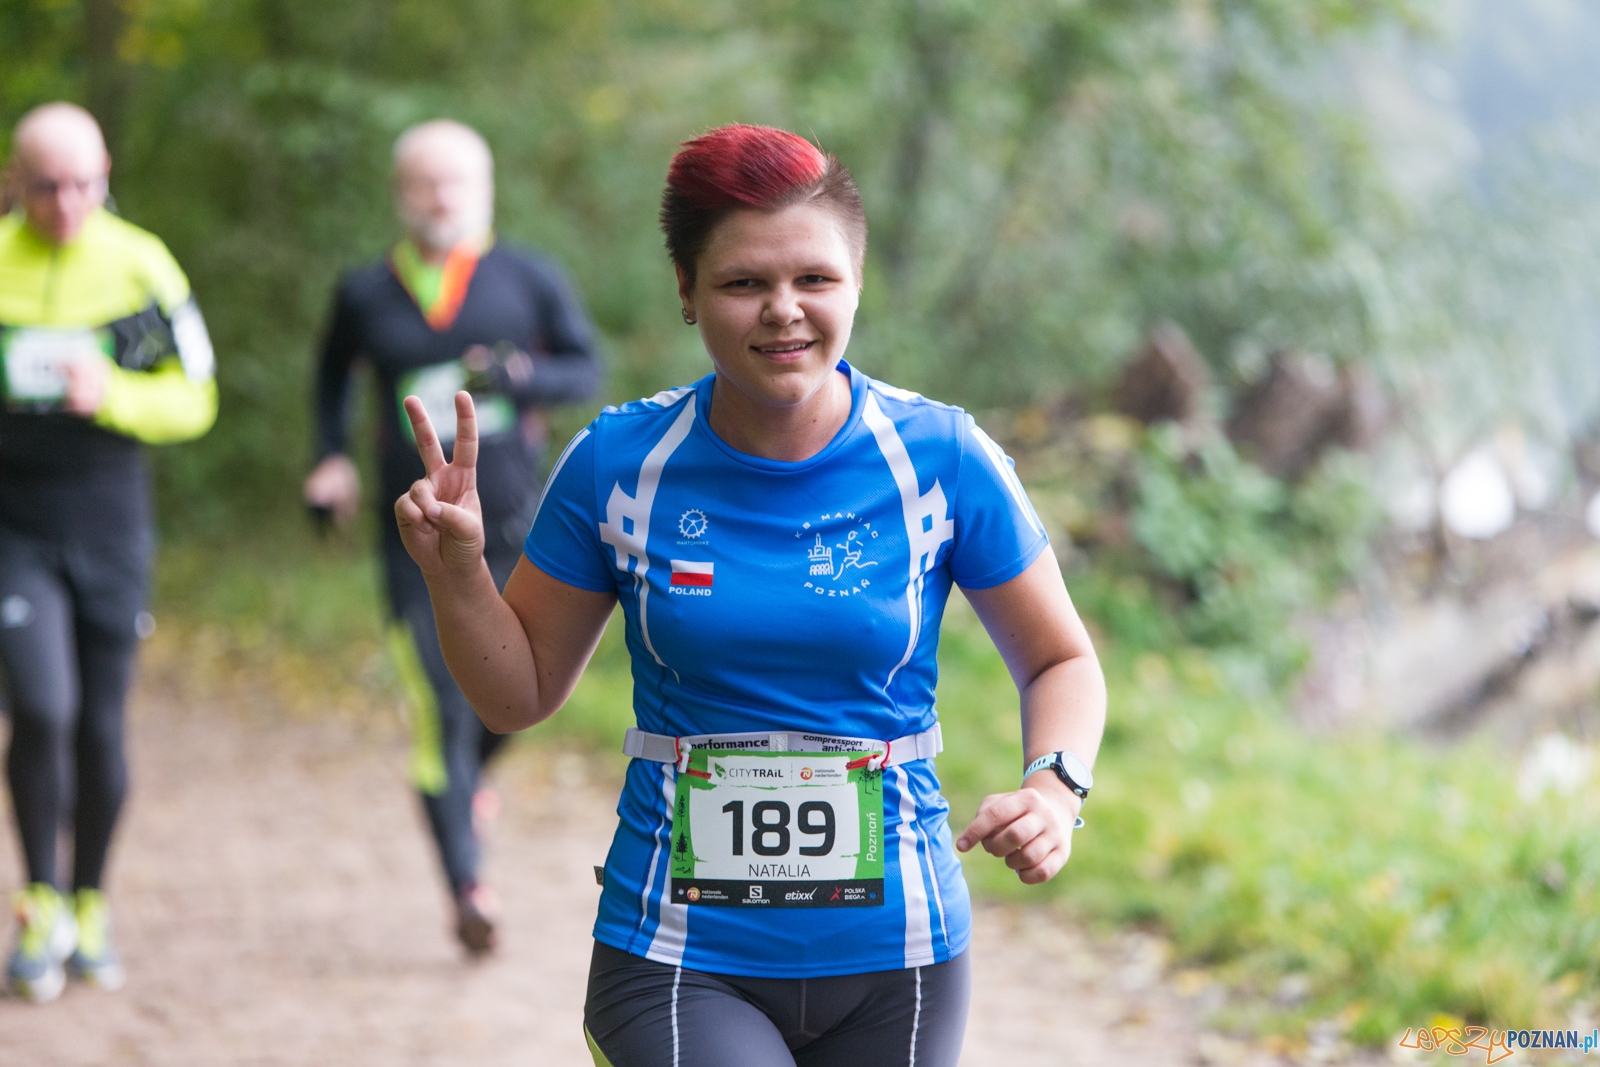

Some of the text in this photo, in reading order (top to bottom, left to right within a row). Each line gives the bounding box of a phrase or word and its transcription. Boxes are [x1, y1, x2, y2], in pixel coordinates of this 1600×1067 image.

[821, 512, 879, 539] MANIAC
[669, 586, 712, 596] POLAND
[803, 734, 863, 747] compressport
[722, 800, 836, 857] 189
[866, 812, 877, 862] Poznań
[748, 864, 811, 877] NATALIA
